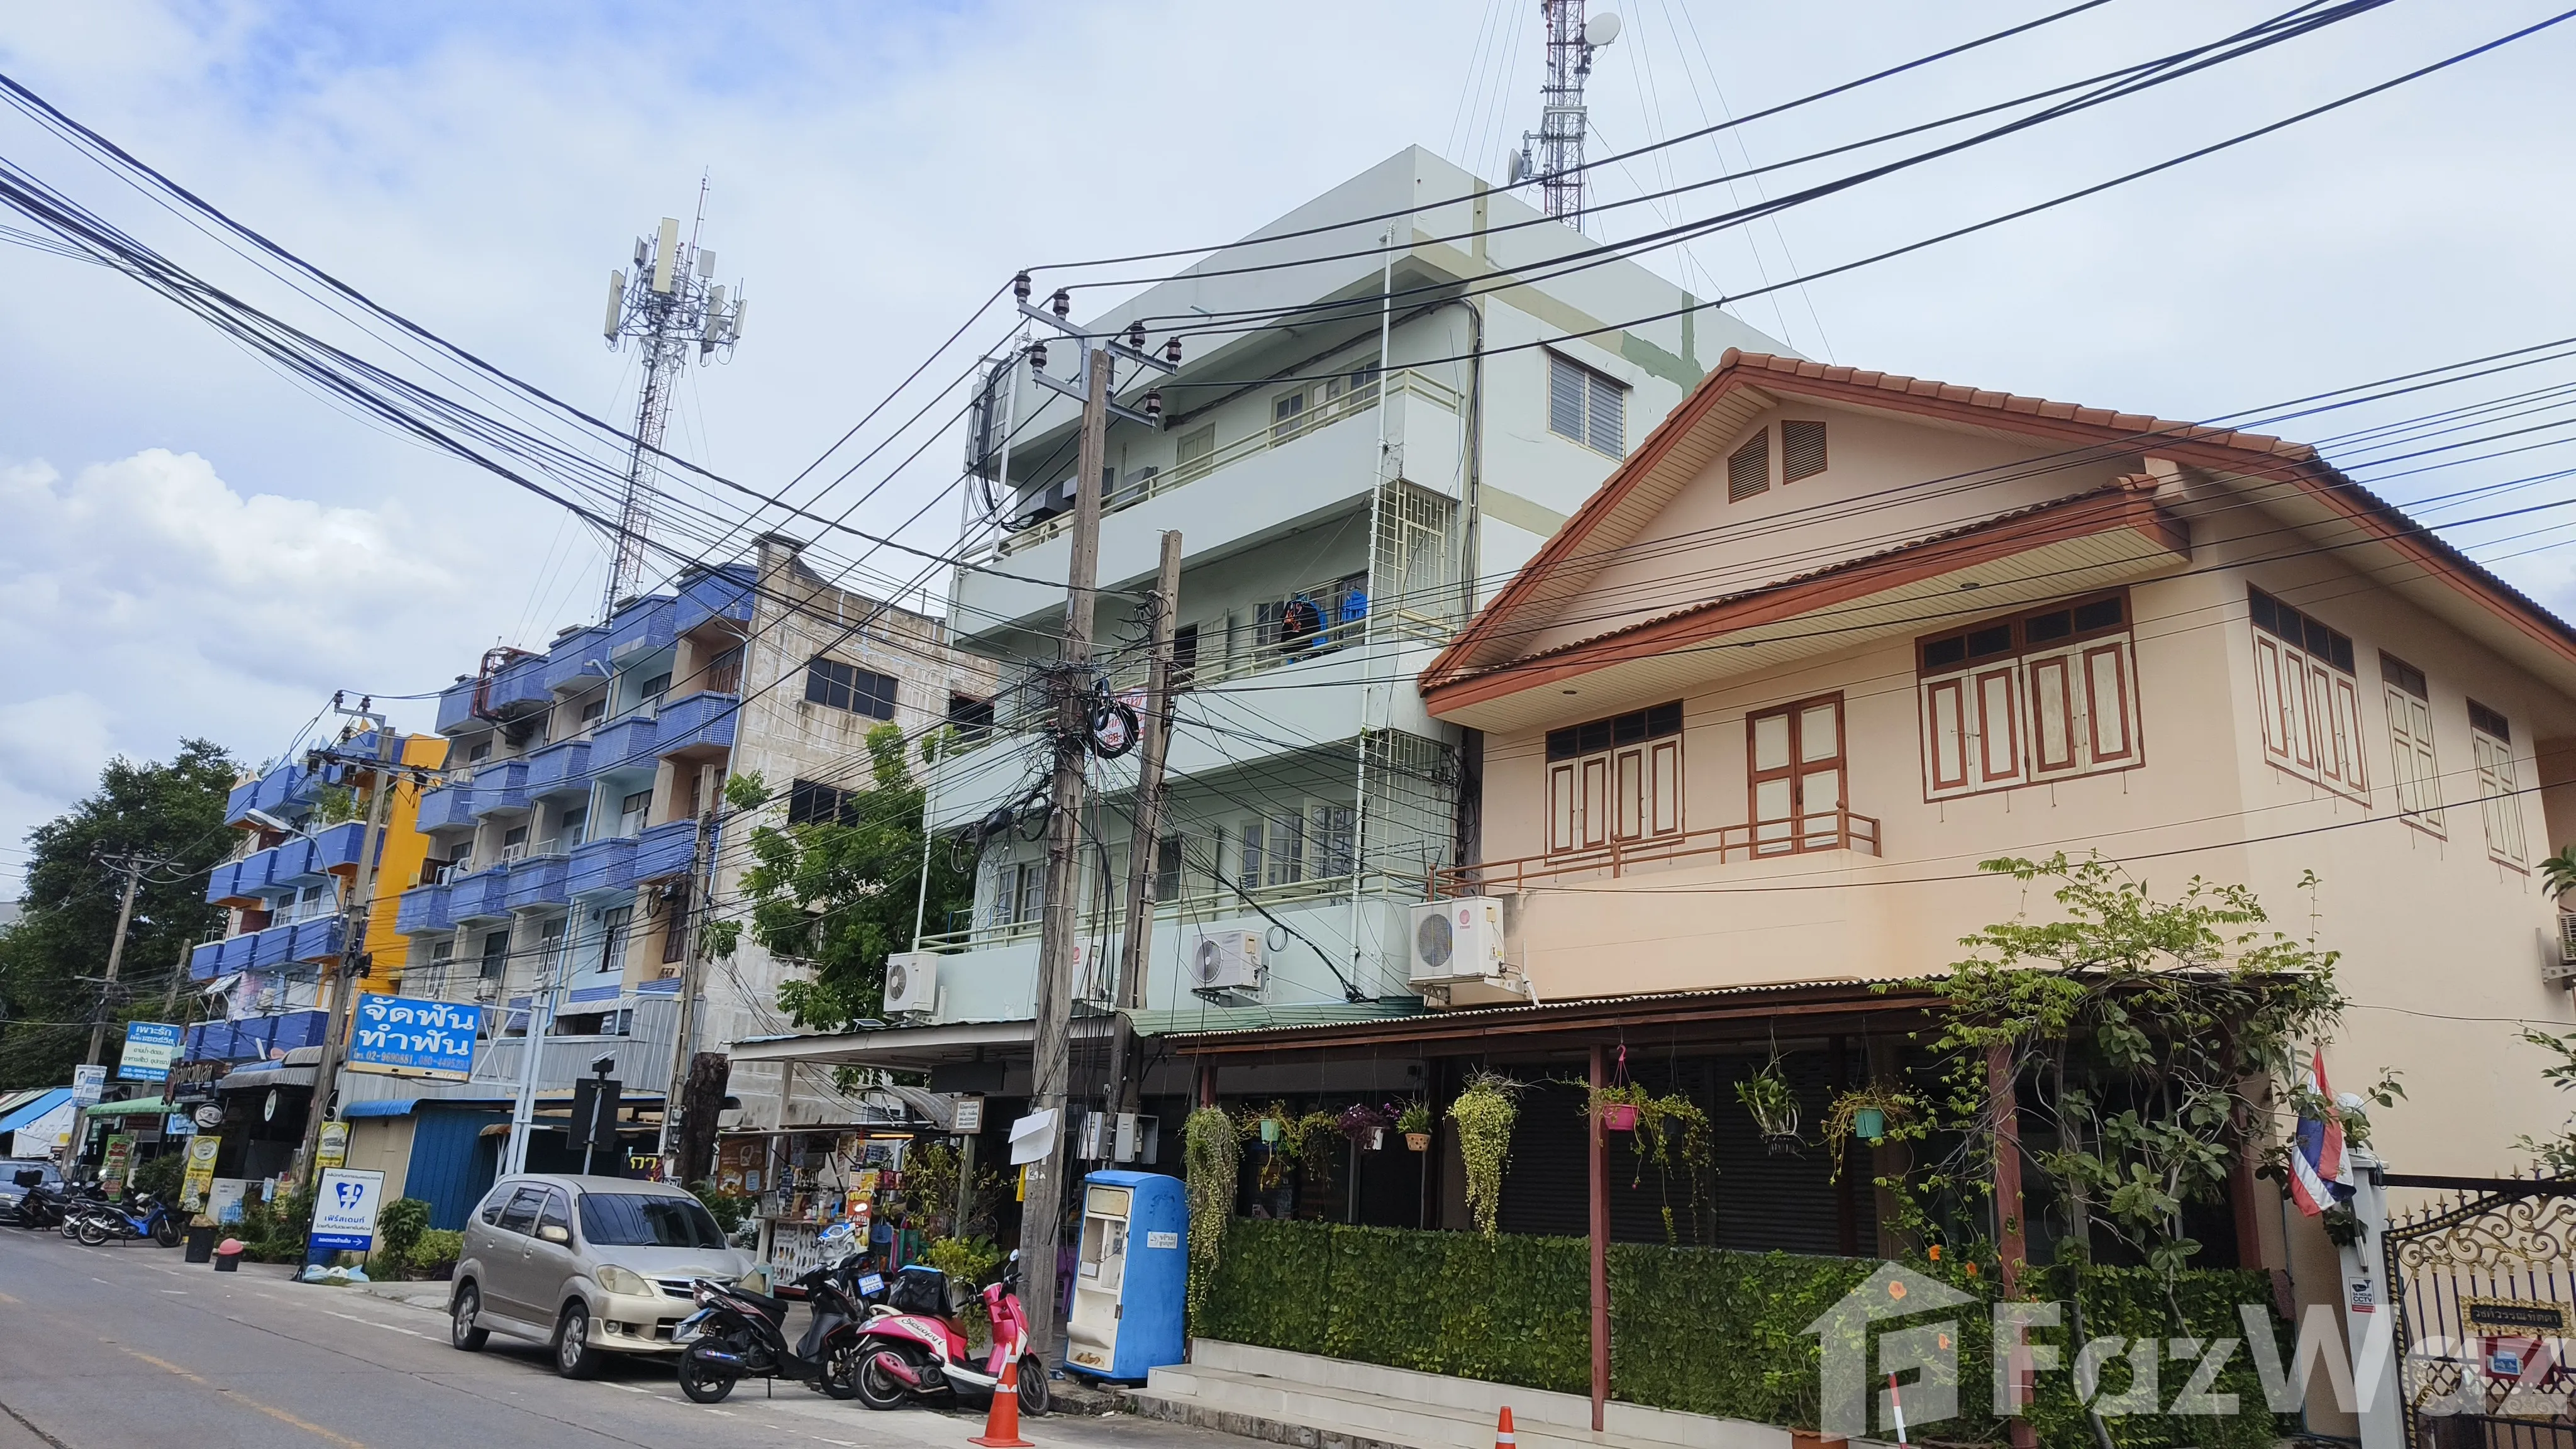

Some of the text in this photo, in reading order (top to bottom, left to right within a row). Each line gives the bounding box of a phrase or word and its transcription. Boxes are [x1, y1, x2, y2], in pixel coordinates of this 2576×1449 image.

[362, 997, 475, 1030] จัดฟัน
[136, 1026, 172, 1036] เพาะรัก
[358, 1024, 469, 1056] ทำฟัน
[901, 1318, 938, 1342] Scoopy
